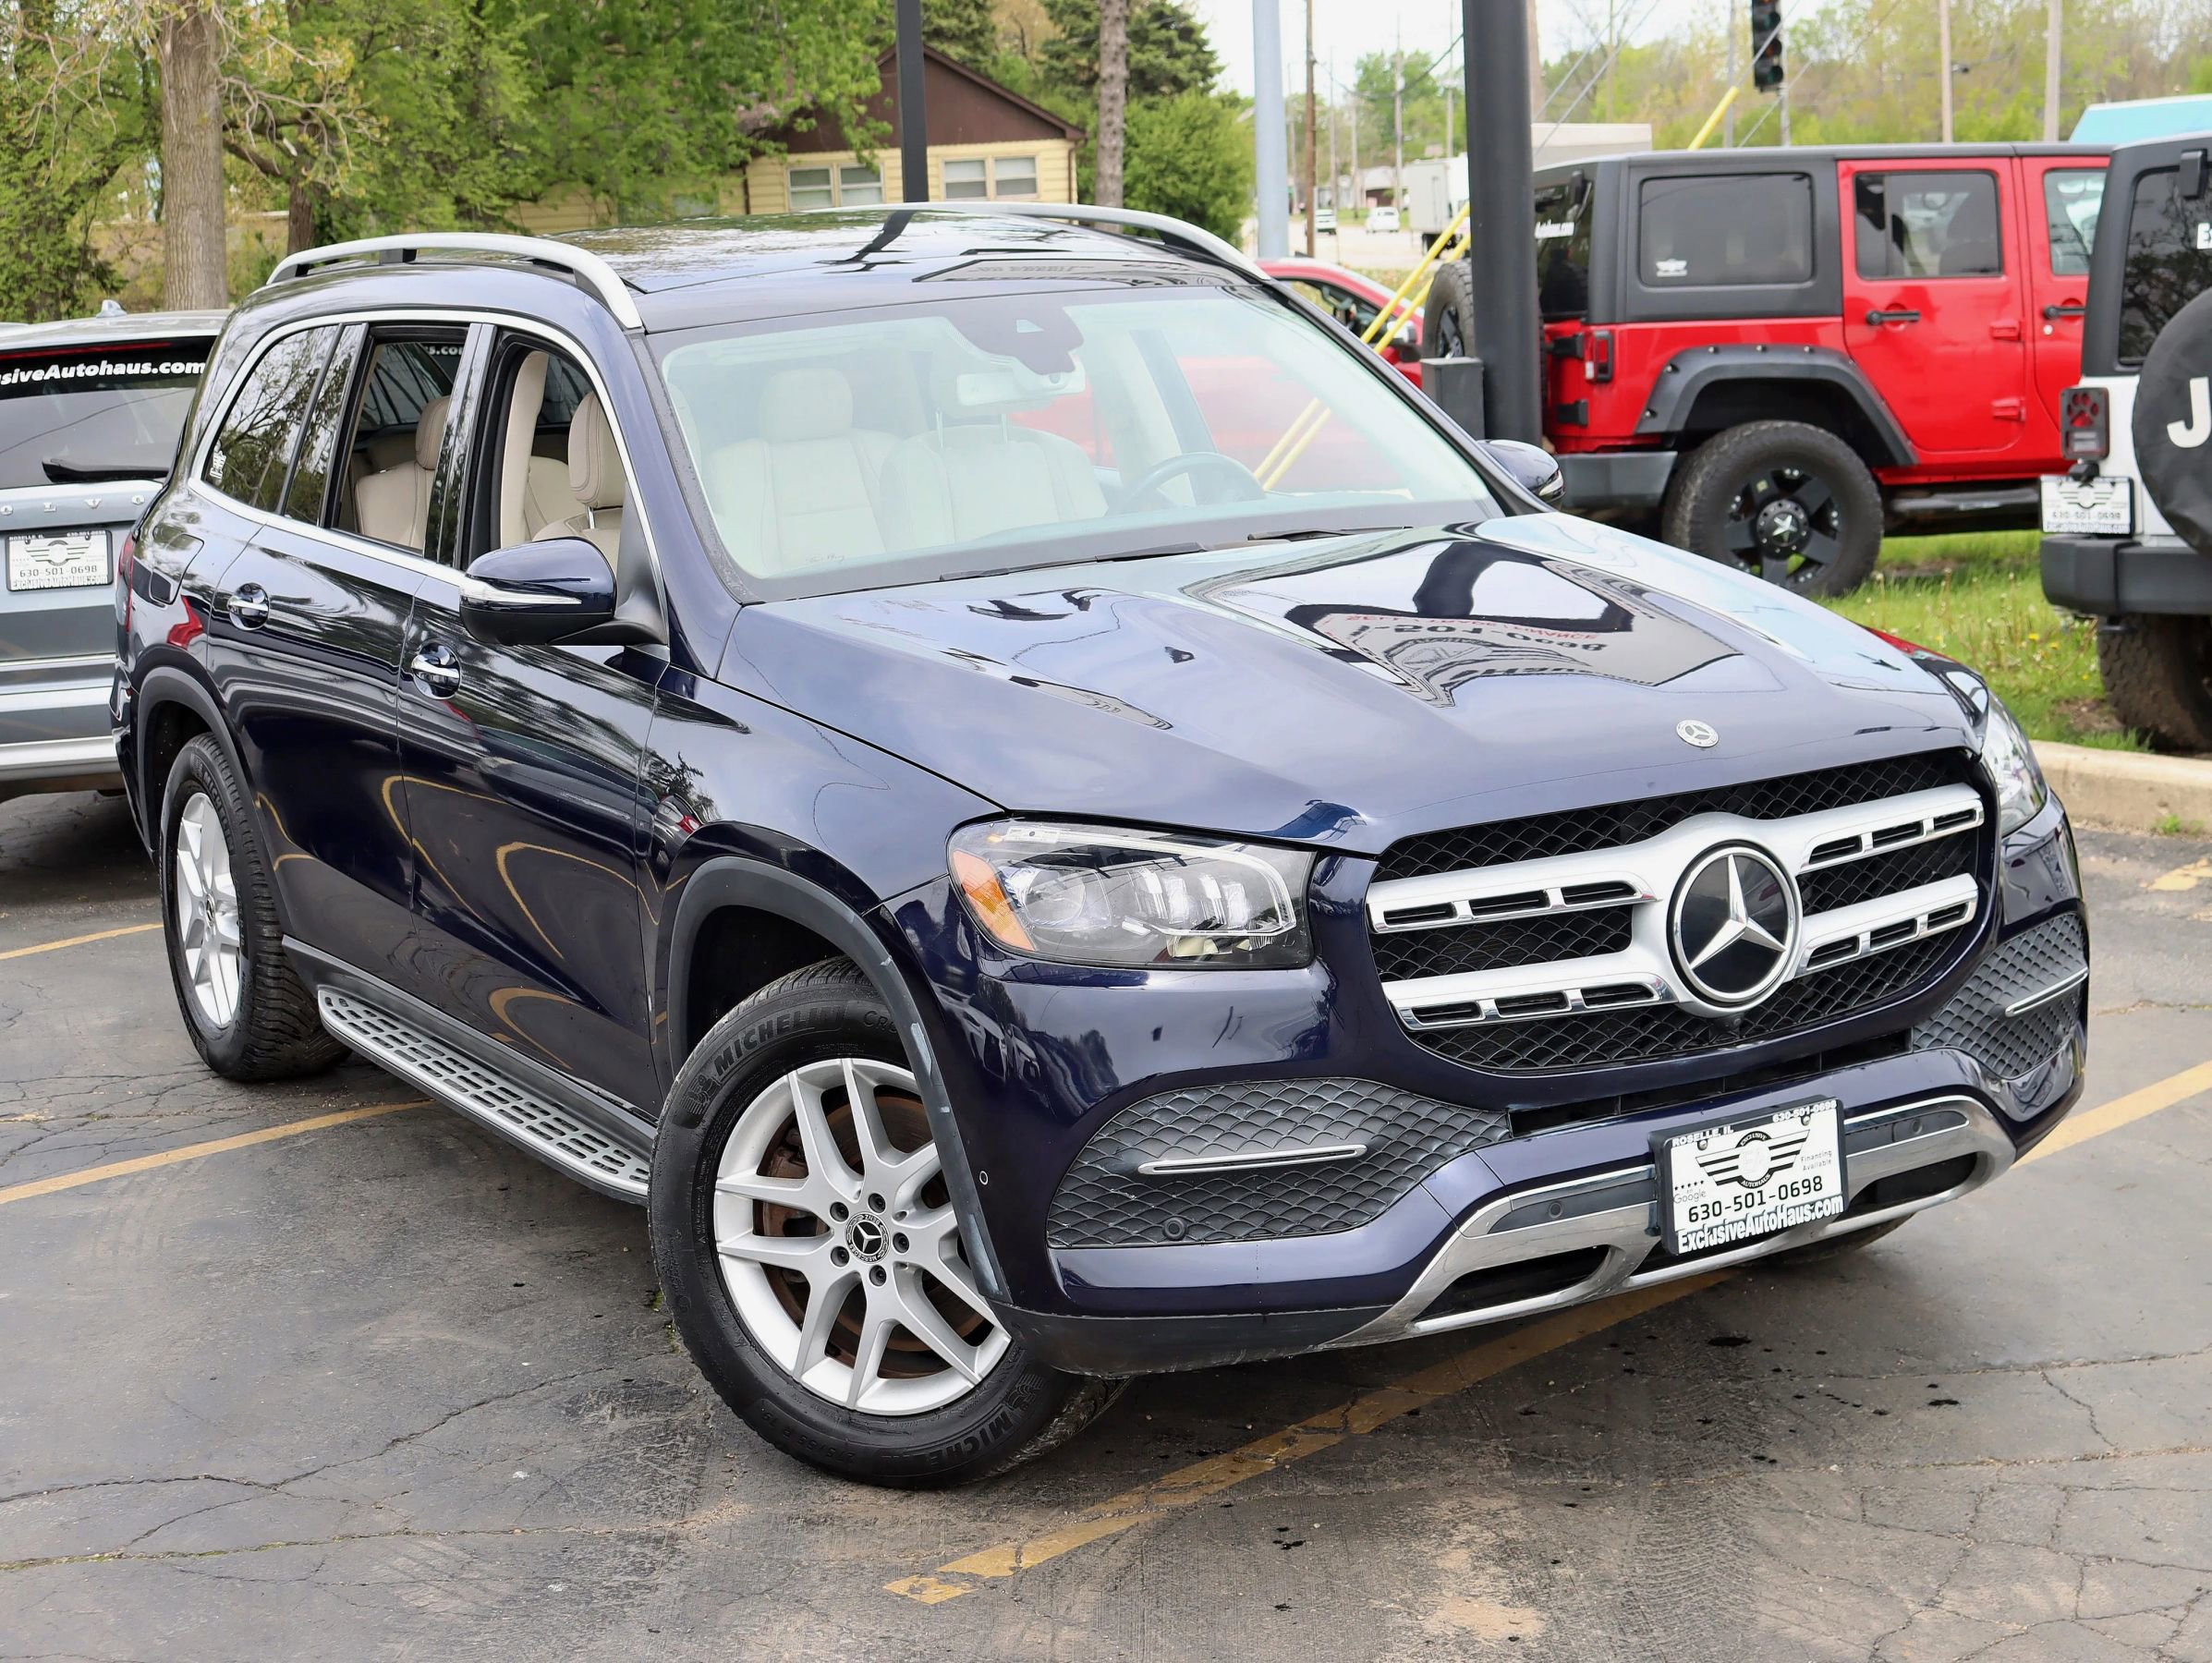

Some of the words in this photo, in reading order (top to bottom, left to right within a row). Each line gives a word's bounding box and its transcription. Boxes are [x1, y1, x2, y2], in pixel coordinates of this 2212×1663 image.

[0, 361, 205, 385] siveAutohaus.com
[19, 564, 98, 577] 630-501-0698
[712, 1005, 841, 1076] MICHELIN
[1772, 1099, 1838, 1123] 630-501-0698
[1740, 1133, 1768, 1147] EXCLUSIVE
[1801, 1149, 1832, 1163] Financing
[1803, 1159, 1832, 1171] Available
[1742, 1173, 1771, 1188] AUTOHAUS
[1673, 1188, 1707, 1205] Google
[1688, 1175, 1823, 1223] 630-501-0698
[1678, 1193, 1844, 1255] ExclusiveAutoHaus.com
